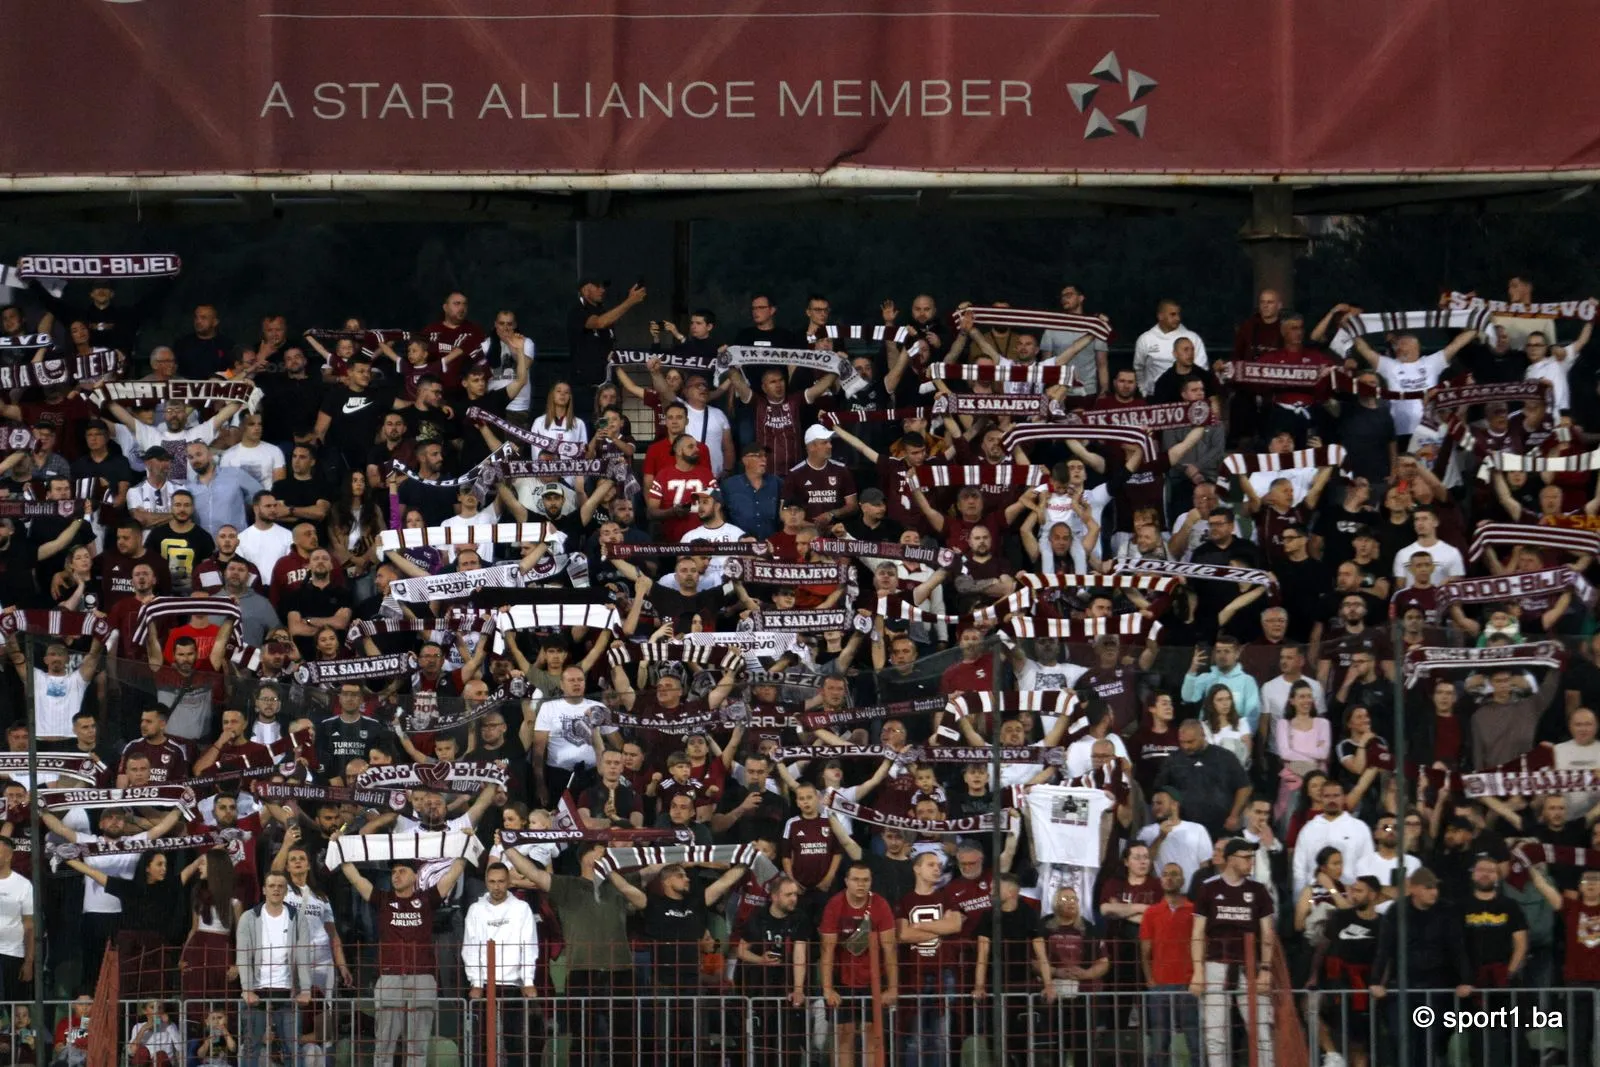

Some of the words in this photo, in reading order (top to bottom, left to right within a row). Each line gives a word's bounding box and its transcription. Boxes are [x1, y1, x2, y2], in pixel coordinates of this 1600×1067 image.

[261, 82, 294, 119] A
[312, 81, 456, 122] STAR
[479, 80, 756, 121] ALLIANCE
[779, 79, 1033, 120] MEMBER
[762, 350, 832, 364] SARAJEVO
[1262, 367, 1318, 380] SARAJEVO
[1461, 383, 1538, 399] SARAJEVO
[348, 397, 367, 407] NIKE
[977, 398, 1040, 411] SARAJEVO
[1110, 406, 1186, 427] SARAJEVO
[531, 459, 602, 475] SARAJEVO
[808, 490, 837, 498] TURKISH
[823, 539, 846, 553] kraju
[849, 541, 879, 555] svijeta
[904, 546, 935, 562] bodriti
[774, 567, 838, 580] SARAJEVO
[427, 579, 487, 596] SARAJEVO
[784, 613, 845, 628] SARAJEVO
[338, 657, 399, 676] SARAJEVO
[828, 711, 853, 723] kraju
[333, 741, 366, 749] TURKISH
[786, 745, 884, 758] SARAJEVO
[64, 790, 108, 802] SINCE
[125, 787, 159, 799] 1946
[267, 785, 290, 798] kraju
[294, 785, 325, 799] svijeta
[354, 790, 386, 804] bodriti
[124, 835, 204, 851] SARAJEVO
[519, 831, 584, 841] SARAJEVO
[391, 911, 421, 920] TURKISH
[390, 918, 423, 928] AIRLINES
